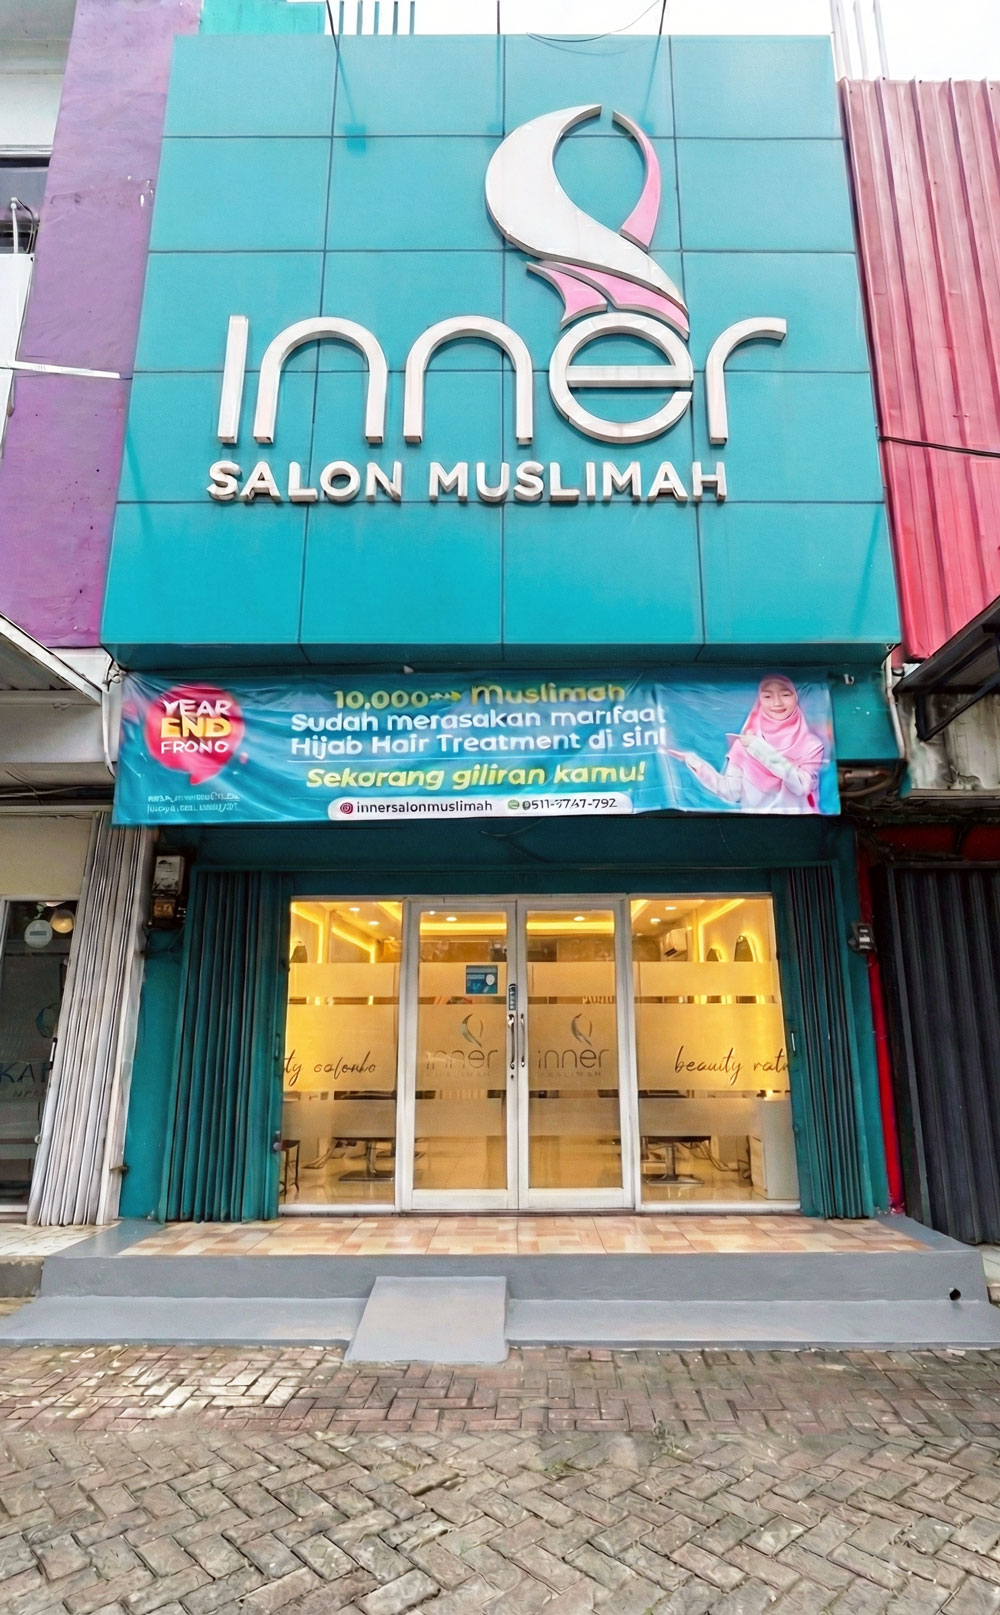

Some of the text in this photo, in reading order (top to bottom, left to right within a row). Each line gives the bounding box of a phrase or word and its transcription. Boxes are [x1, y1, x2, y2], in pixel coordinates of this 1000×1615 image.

[206, 460, 727, 503] SALON MUSLIMAH
[471, 682, 626, 706] Muslimah
[160, 699, 232, 717] YEAR
[291, 712, 379, 732] Sudah
[387, 708, 541, 732] merasakan
[160, 716, 232, 739] END
[291, 734, 363, 760] Hijab
[371, 733, 429, 755] Hair
[436, 731, 581, 754] Treatment
[588, 728, 612, 751] di
[452, 763, 546, 791] giliran
[553, 760, 647, 785] kamu!
[356, 799, 492, 814] innersalonmuslimah
[537, 1048, 610, 1070] inner
